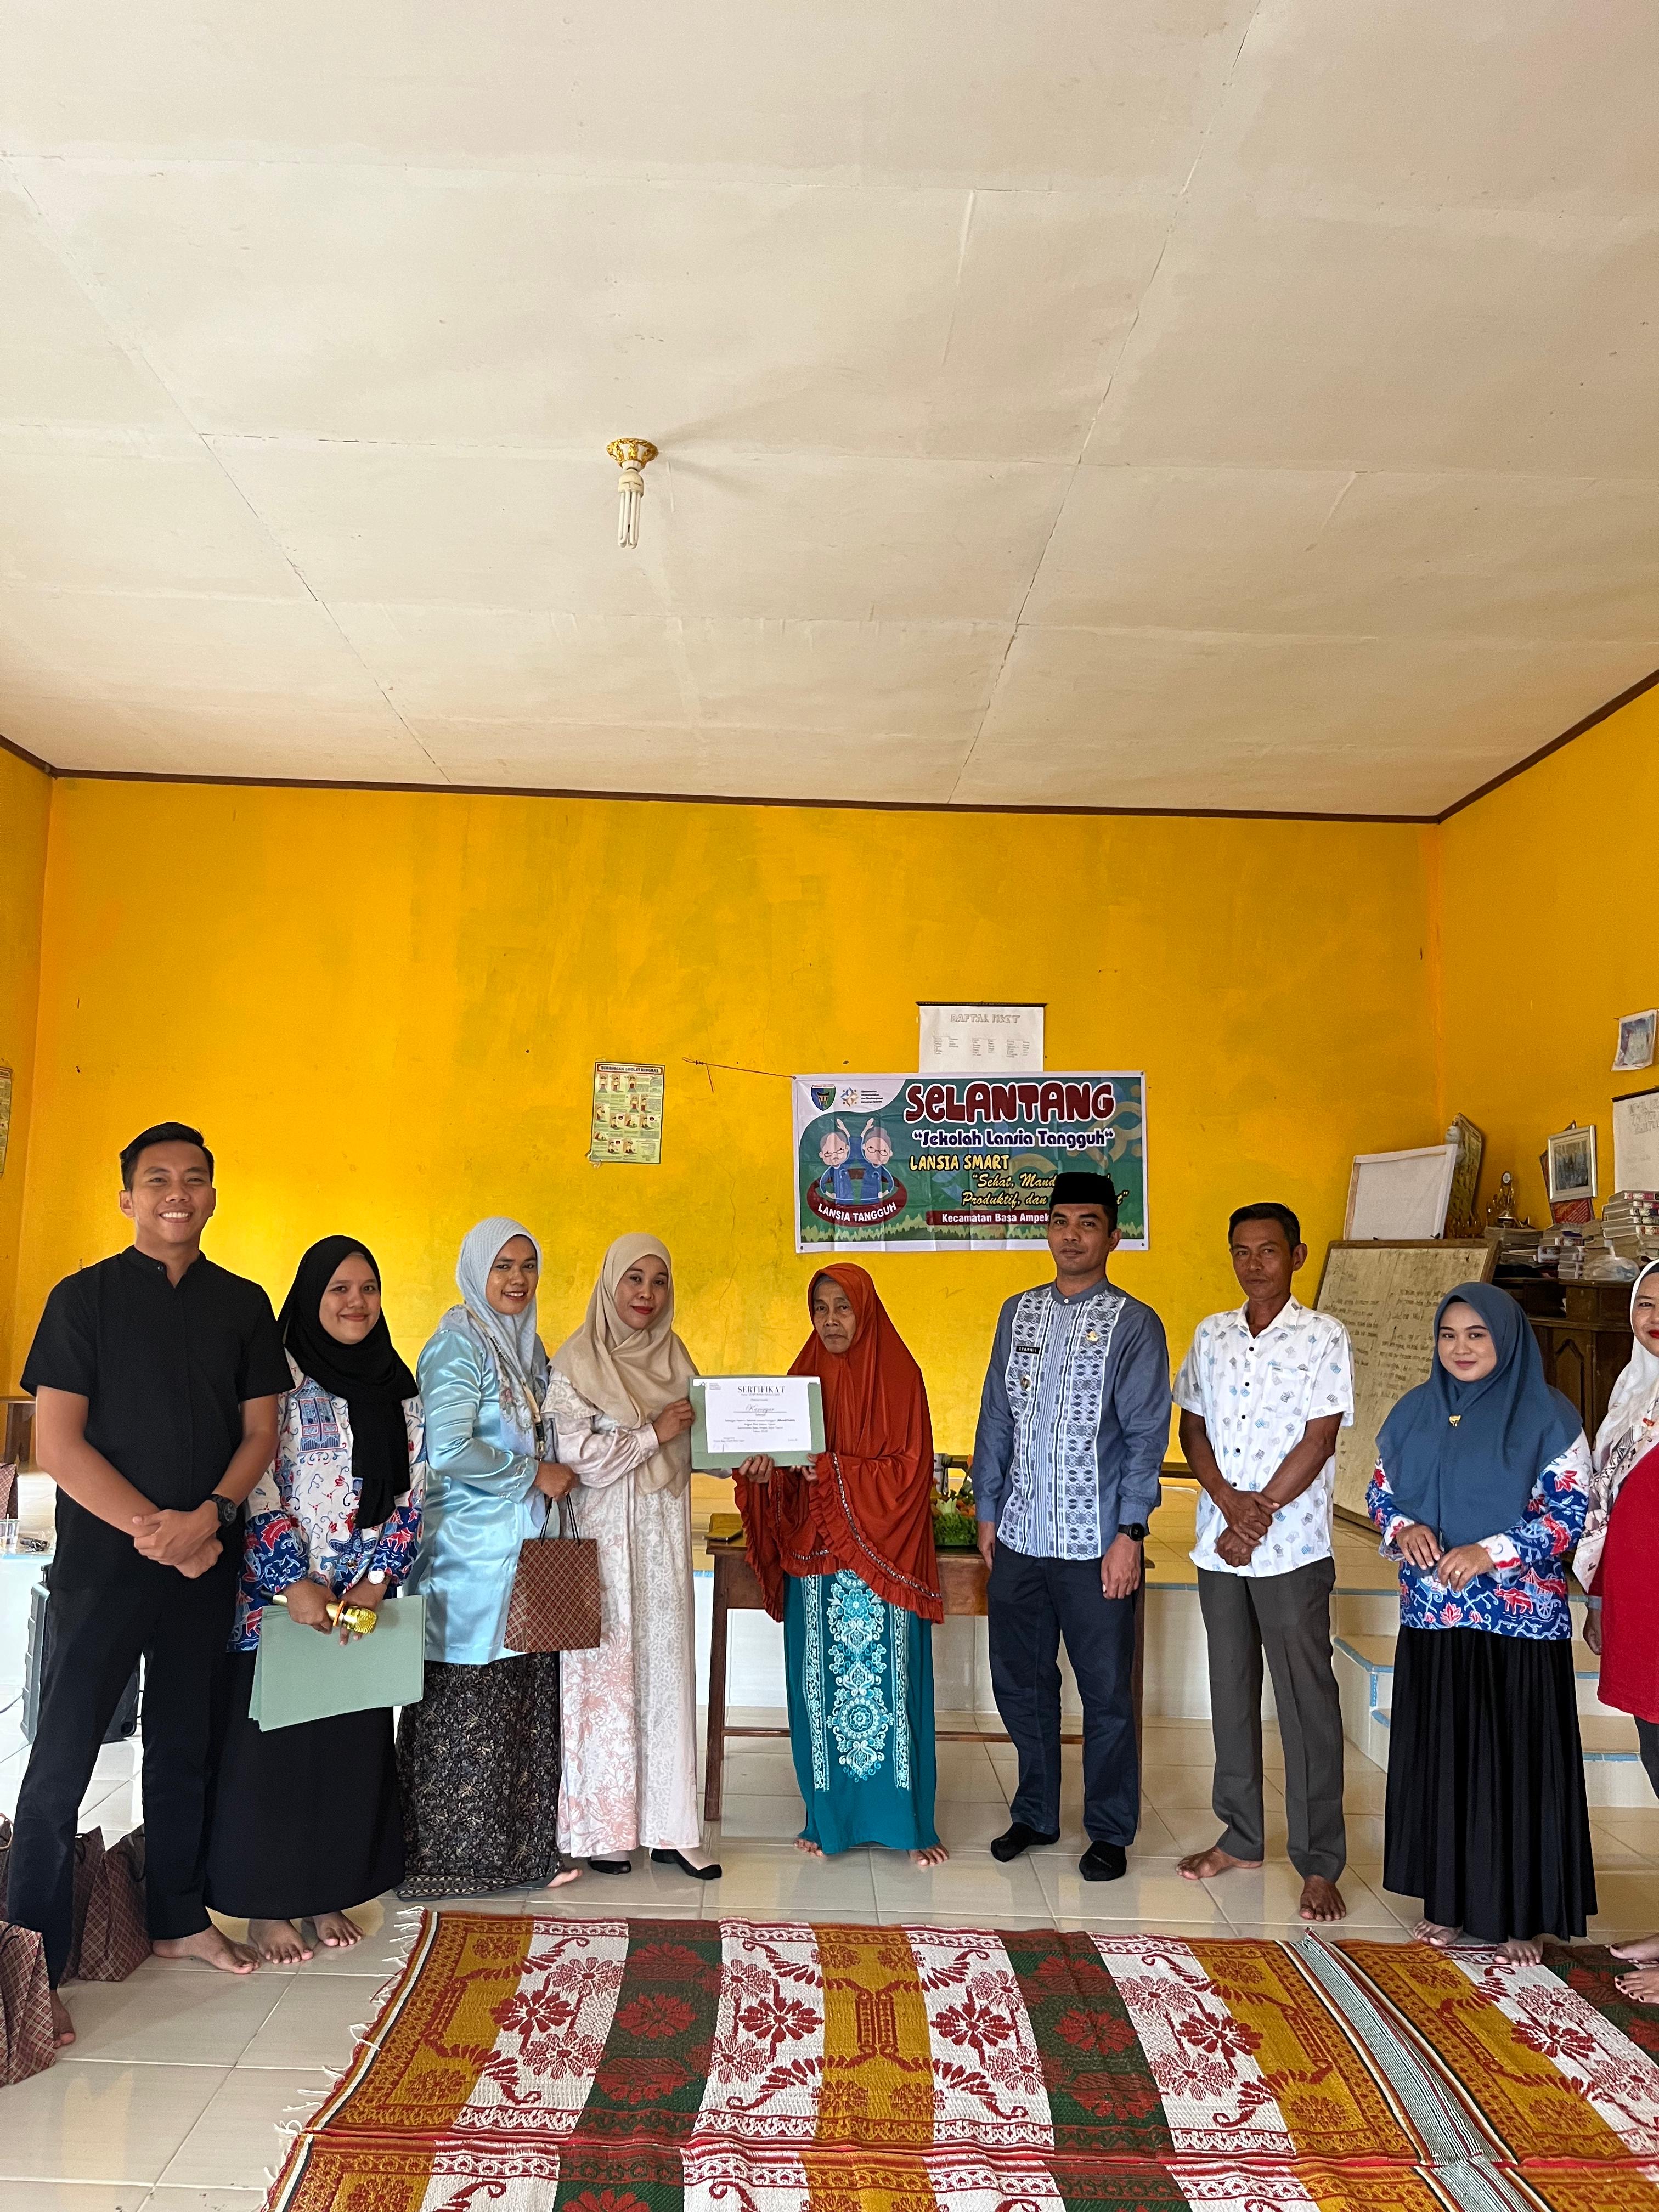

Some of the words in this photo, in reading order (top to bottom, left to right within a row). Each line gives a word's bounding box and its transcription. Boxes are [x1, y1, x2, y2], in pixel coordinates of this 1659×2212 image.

[988, 1131, 1033, 1146] Lansia
[910, 1155, 959, 1171] LANSIA
[964, 1154, 1009, 1170] SMART
[1020, 1174, 1057, 1187] Mand
[962, 1191, 1020, 1209] Produktif,
[1025, 1192, 1047, 1205] dan
[817, 1203, 850, 1222] LANSIA
[852, 1201, 897, 1222] TANGGUH
[942, 1213, 992, 1223] Kecamatan
[995, 1213, 1018, 1222] Basa
[1019, 1213, 1049, 1223] Ampek
